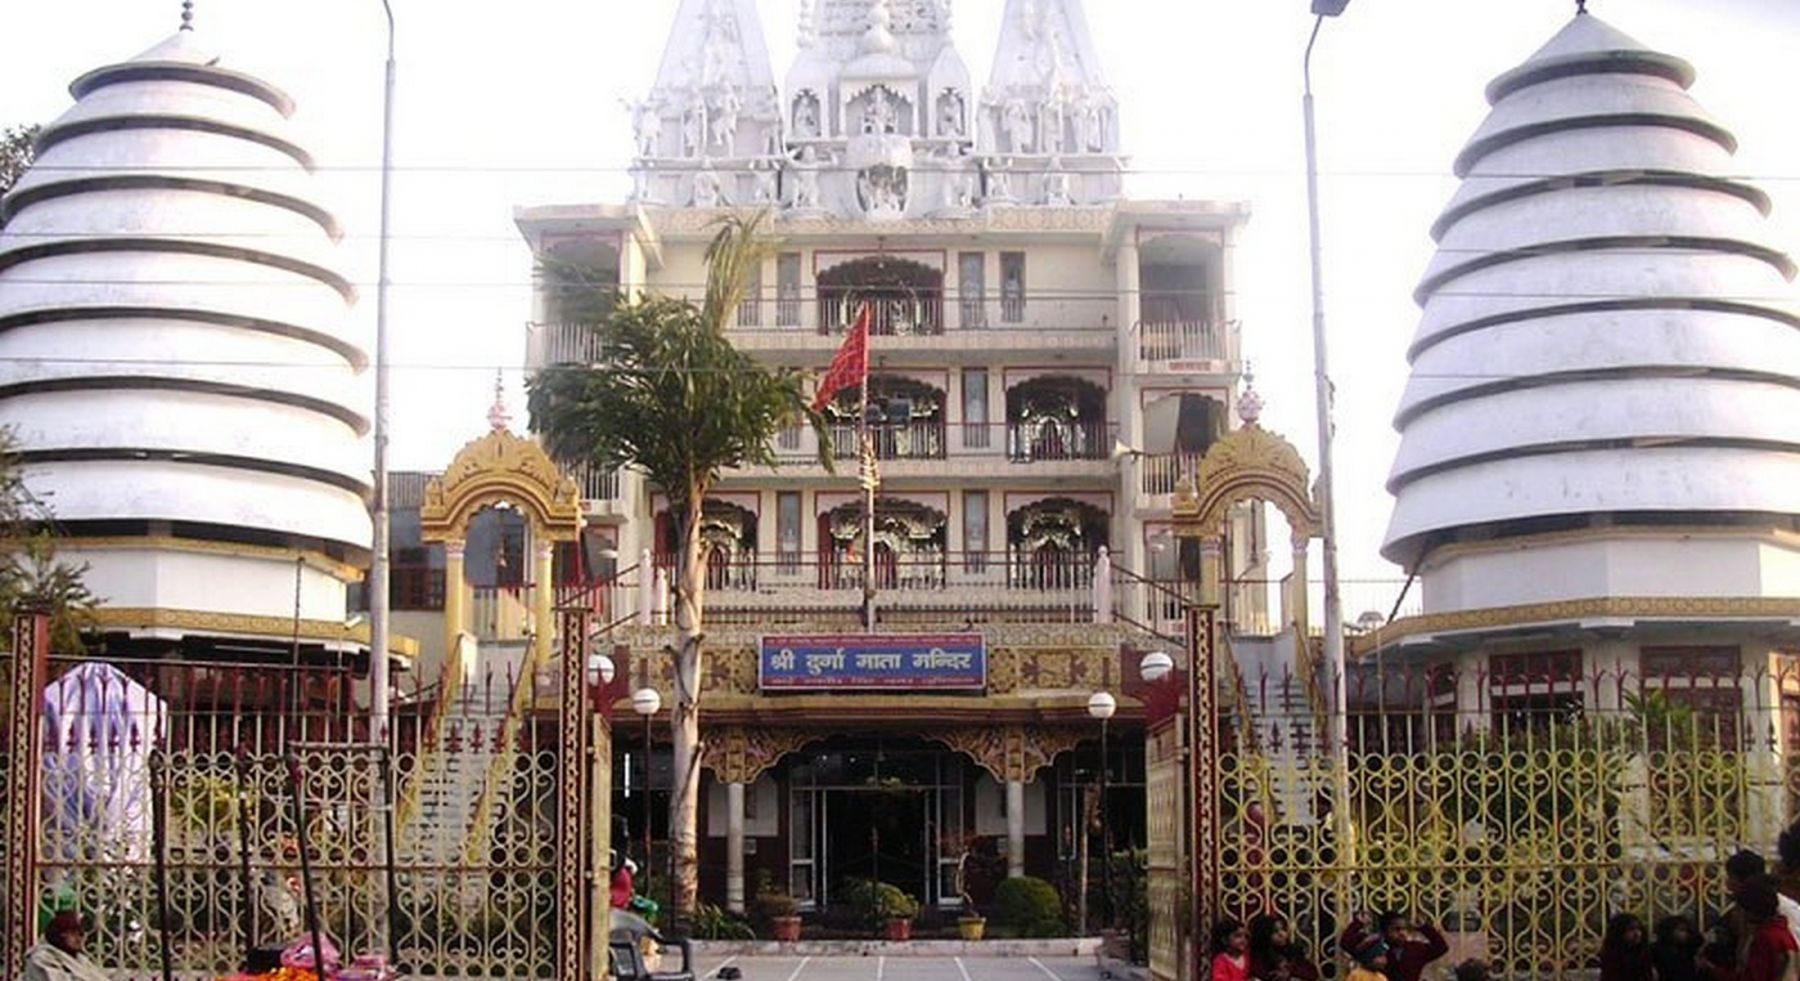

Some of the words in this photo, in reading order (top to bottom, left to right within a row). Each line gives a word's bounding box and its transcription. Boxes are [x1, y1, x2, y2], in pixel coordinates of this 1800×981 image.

[771, 648, 794, 670] श्री
[806, 648, 845, 675] दुर्गा
[856, 654, 901, 670] माता
[913, 648, 972, 670] मन्दिर
